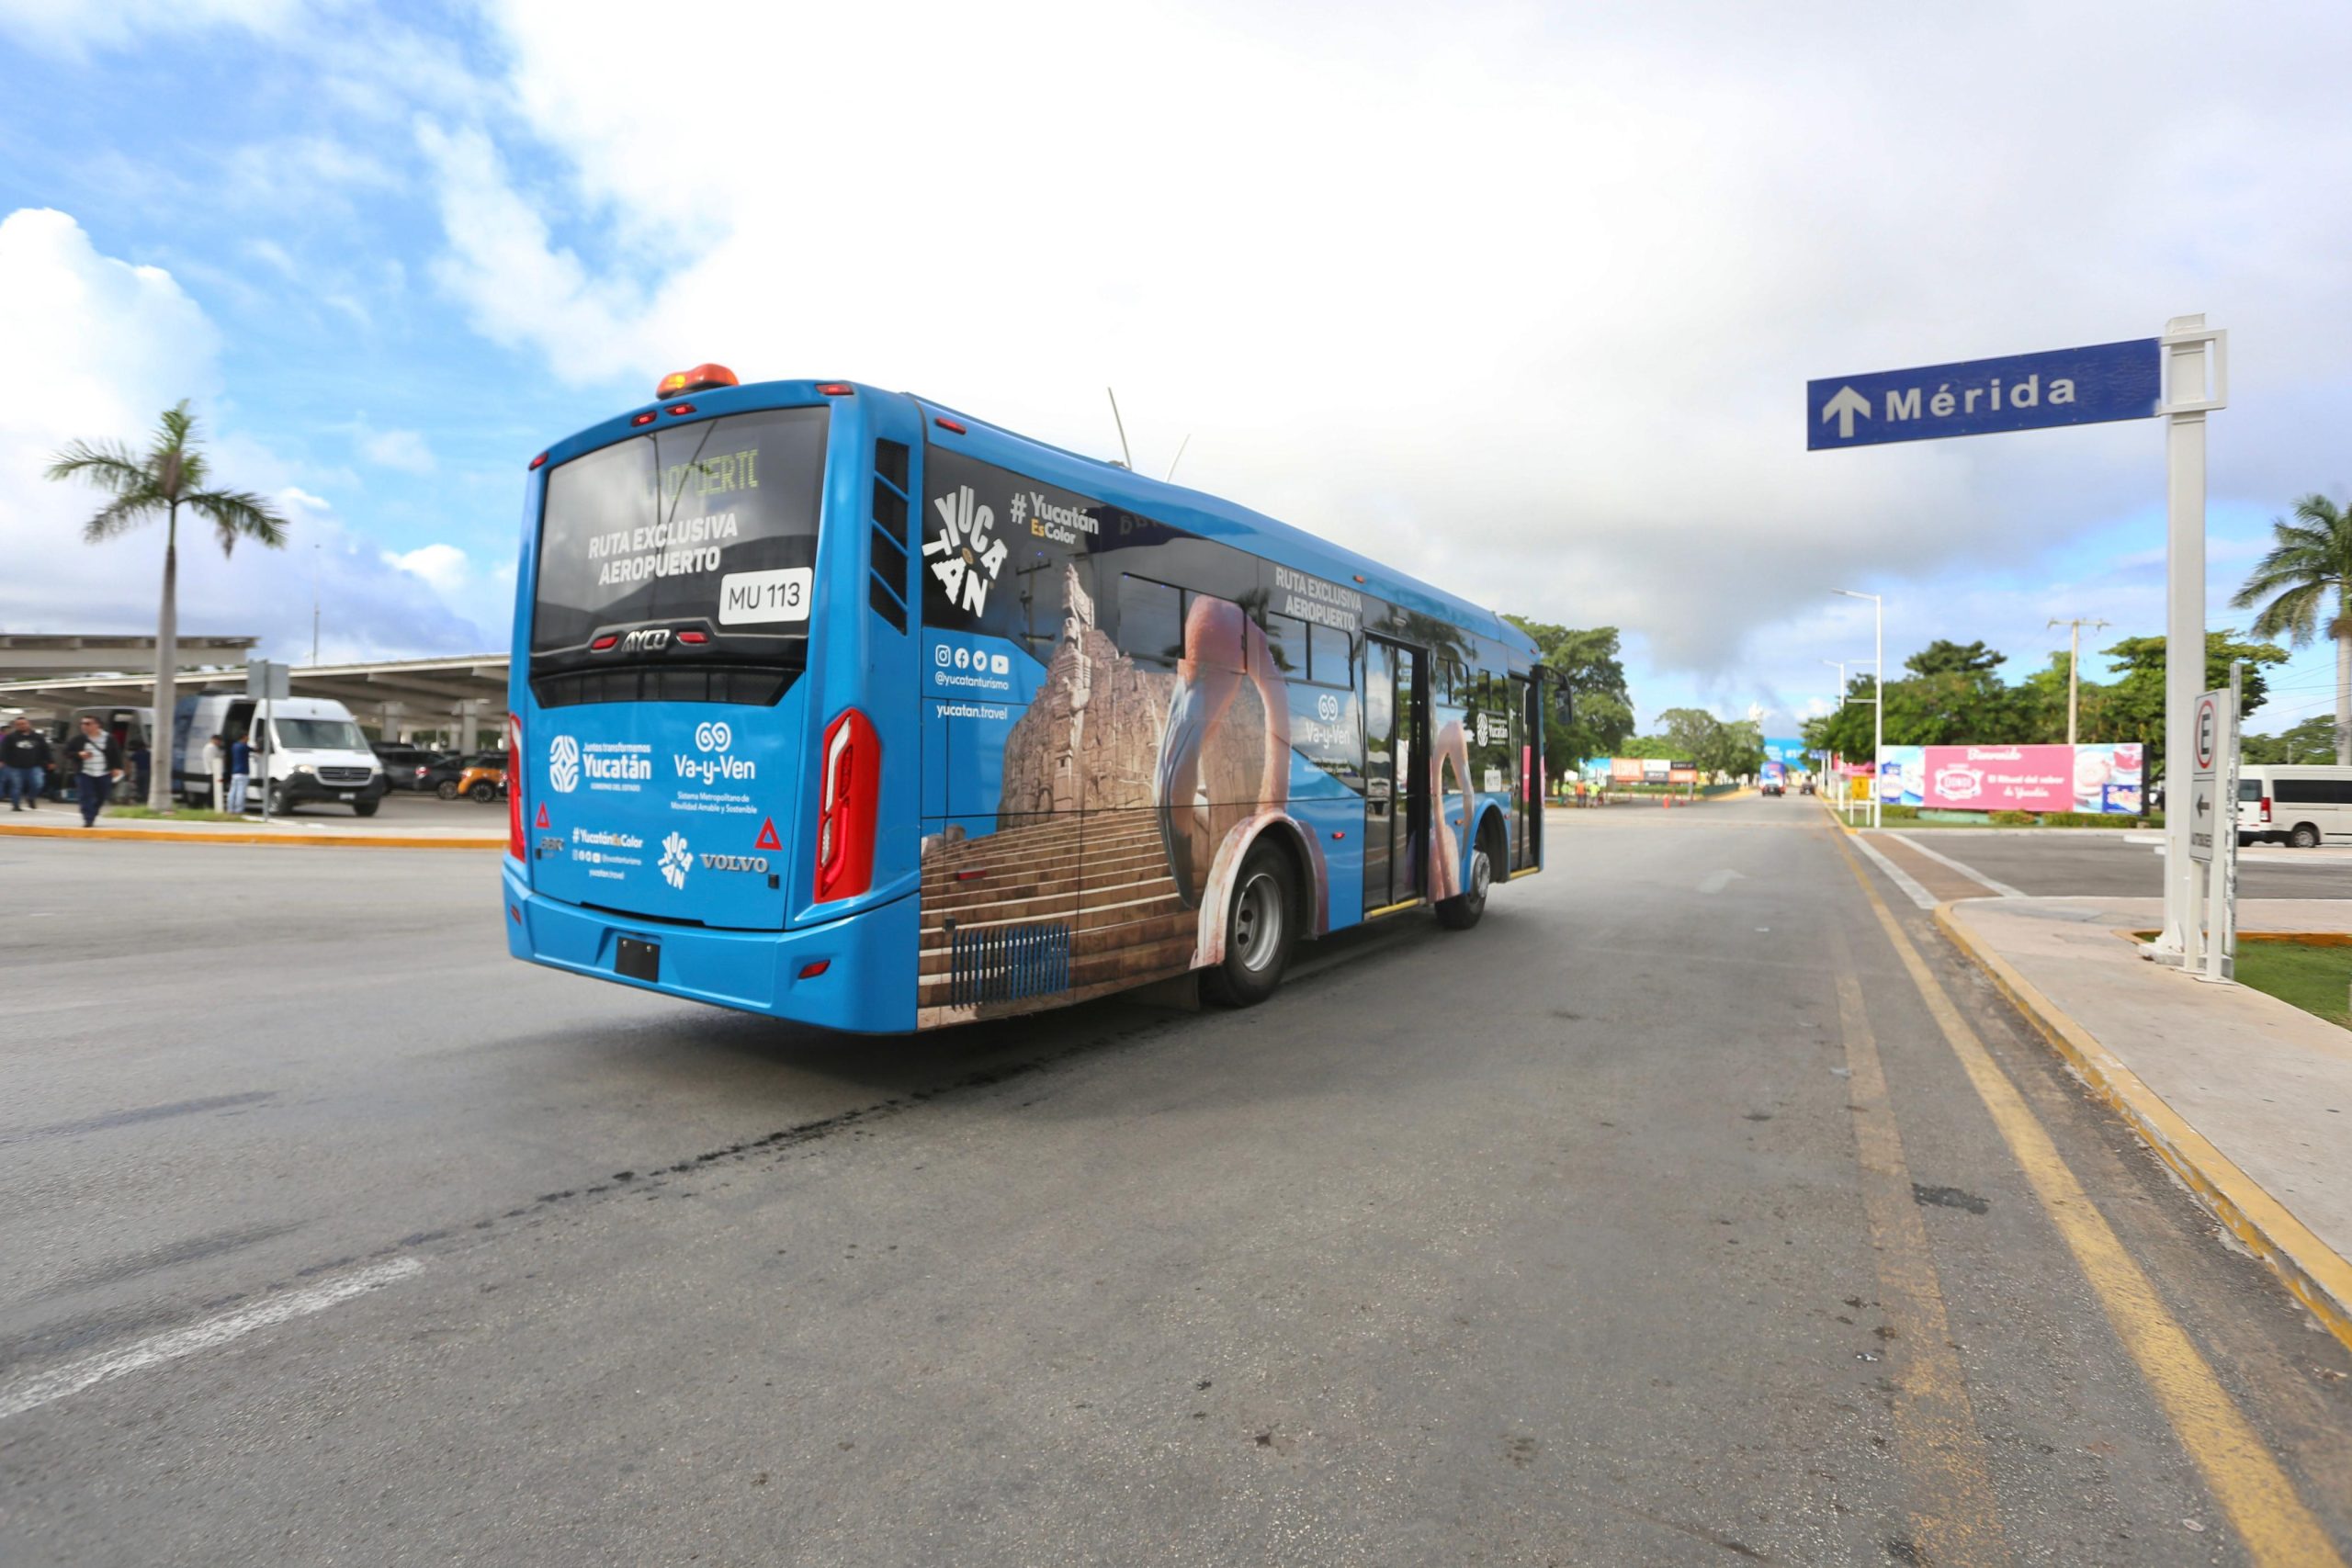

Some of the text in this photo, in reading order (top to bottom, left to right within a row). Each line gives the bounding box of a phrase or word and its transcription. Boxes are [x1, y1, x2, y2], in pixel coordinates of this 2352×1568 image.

[1885, 374, 2076, 423] Mérida
[588, 513, 738, 559] RUTA EXCLUSIVA
[1031, 517, 1076, 545] EsColor
[598, 546, 721, 586] AEROPUERTO
[729, 581, 800, 611] MU 113
[1276, 566, 1363, 613] RUTA EXCLUSIVA
[1285, 594, 1355, 631] AEROPUERTO
[934, 671, 1009, 691] @yucatanturismo
[936, 704, 1008, 720] yucatan.travel
[1306, 721, 1351, 750] Va-y-Ven
[2200, 713, 2211, 755] E
[582, 753, 651, 780] Yucatán
[673, 754, 755, 785] Va-y-Ven
[699, 853, 769, 873] VOLVO
